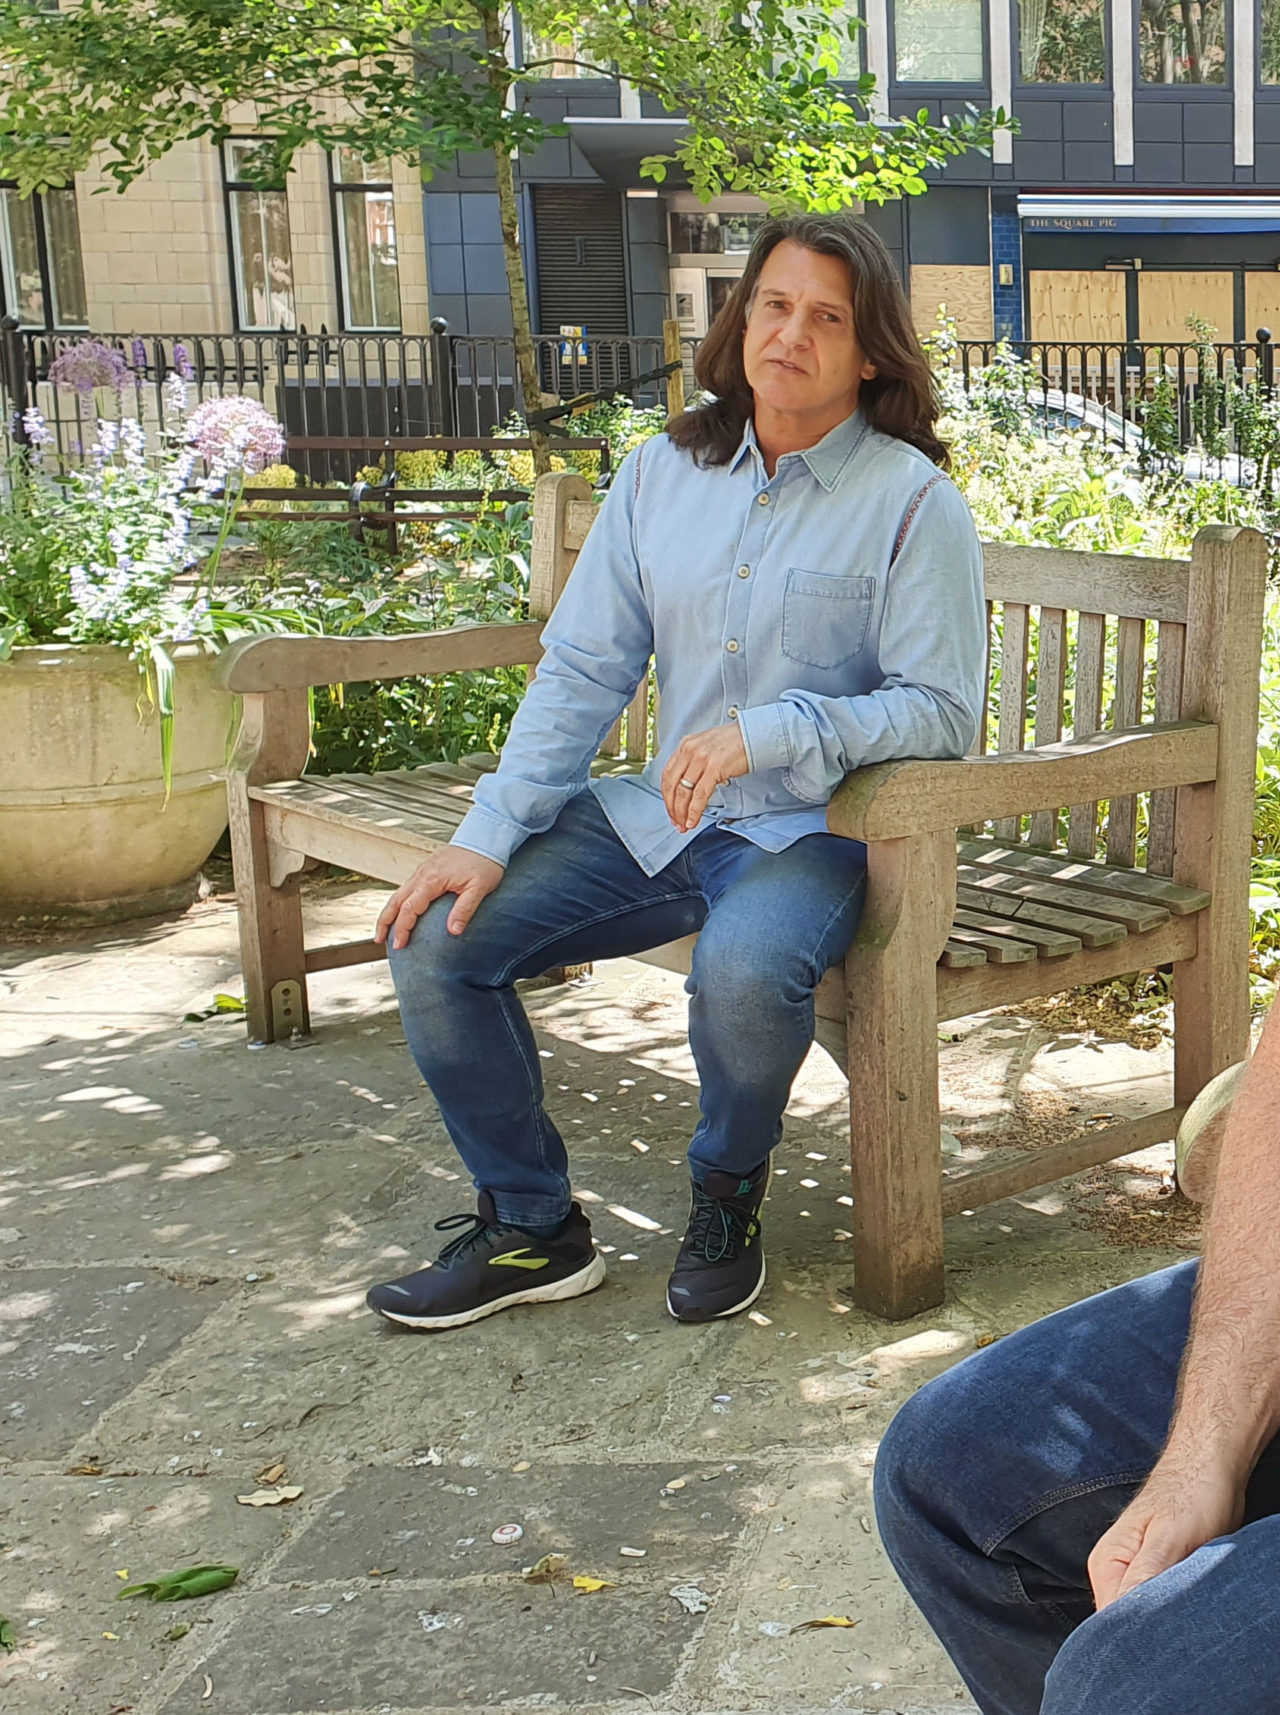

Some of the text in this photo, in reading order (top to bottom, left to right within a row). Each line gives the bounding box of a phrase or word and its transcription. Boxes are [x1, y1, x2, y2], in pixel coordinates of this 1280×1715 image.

[1031, 219, 1117, 230] THE SQUARE PIG
